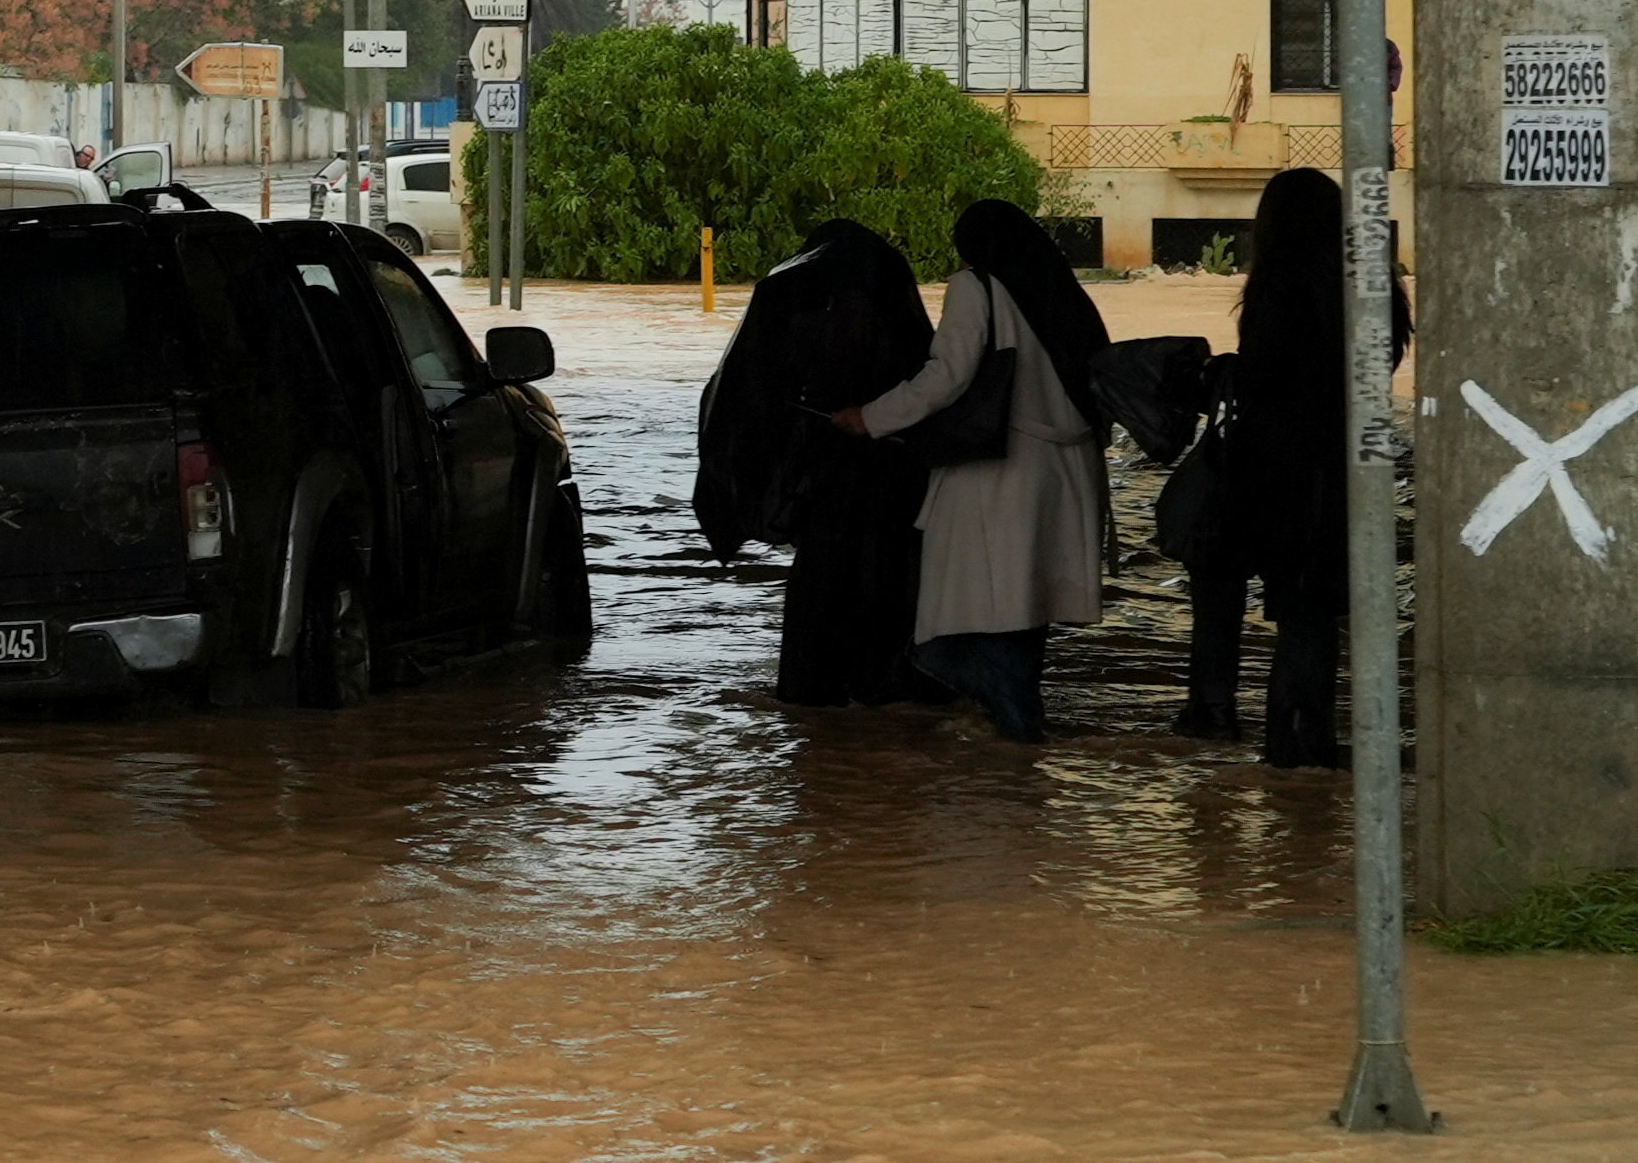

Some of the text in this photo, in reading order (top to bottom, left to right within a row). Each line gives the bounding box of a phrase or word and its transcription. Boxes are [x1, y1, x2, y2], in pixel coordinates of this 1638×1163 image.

[474, 5, 524, 17] ARIANA VILLE
[348, 37, 402, 57] سبحان الله
[1505, 61, 1606, 98] 58222666
[1504, 128, 1606, 182] 29255999
